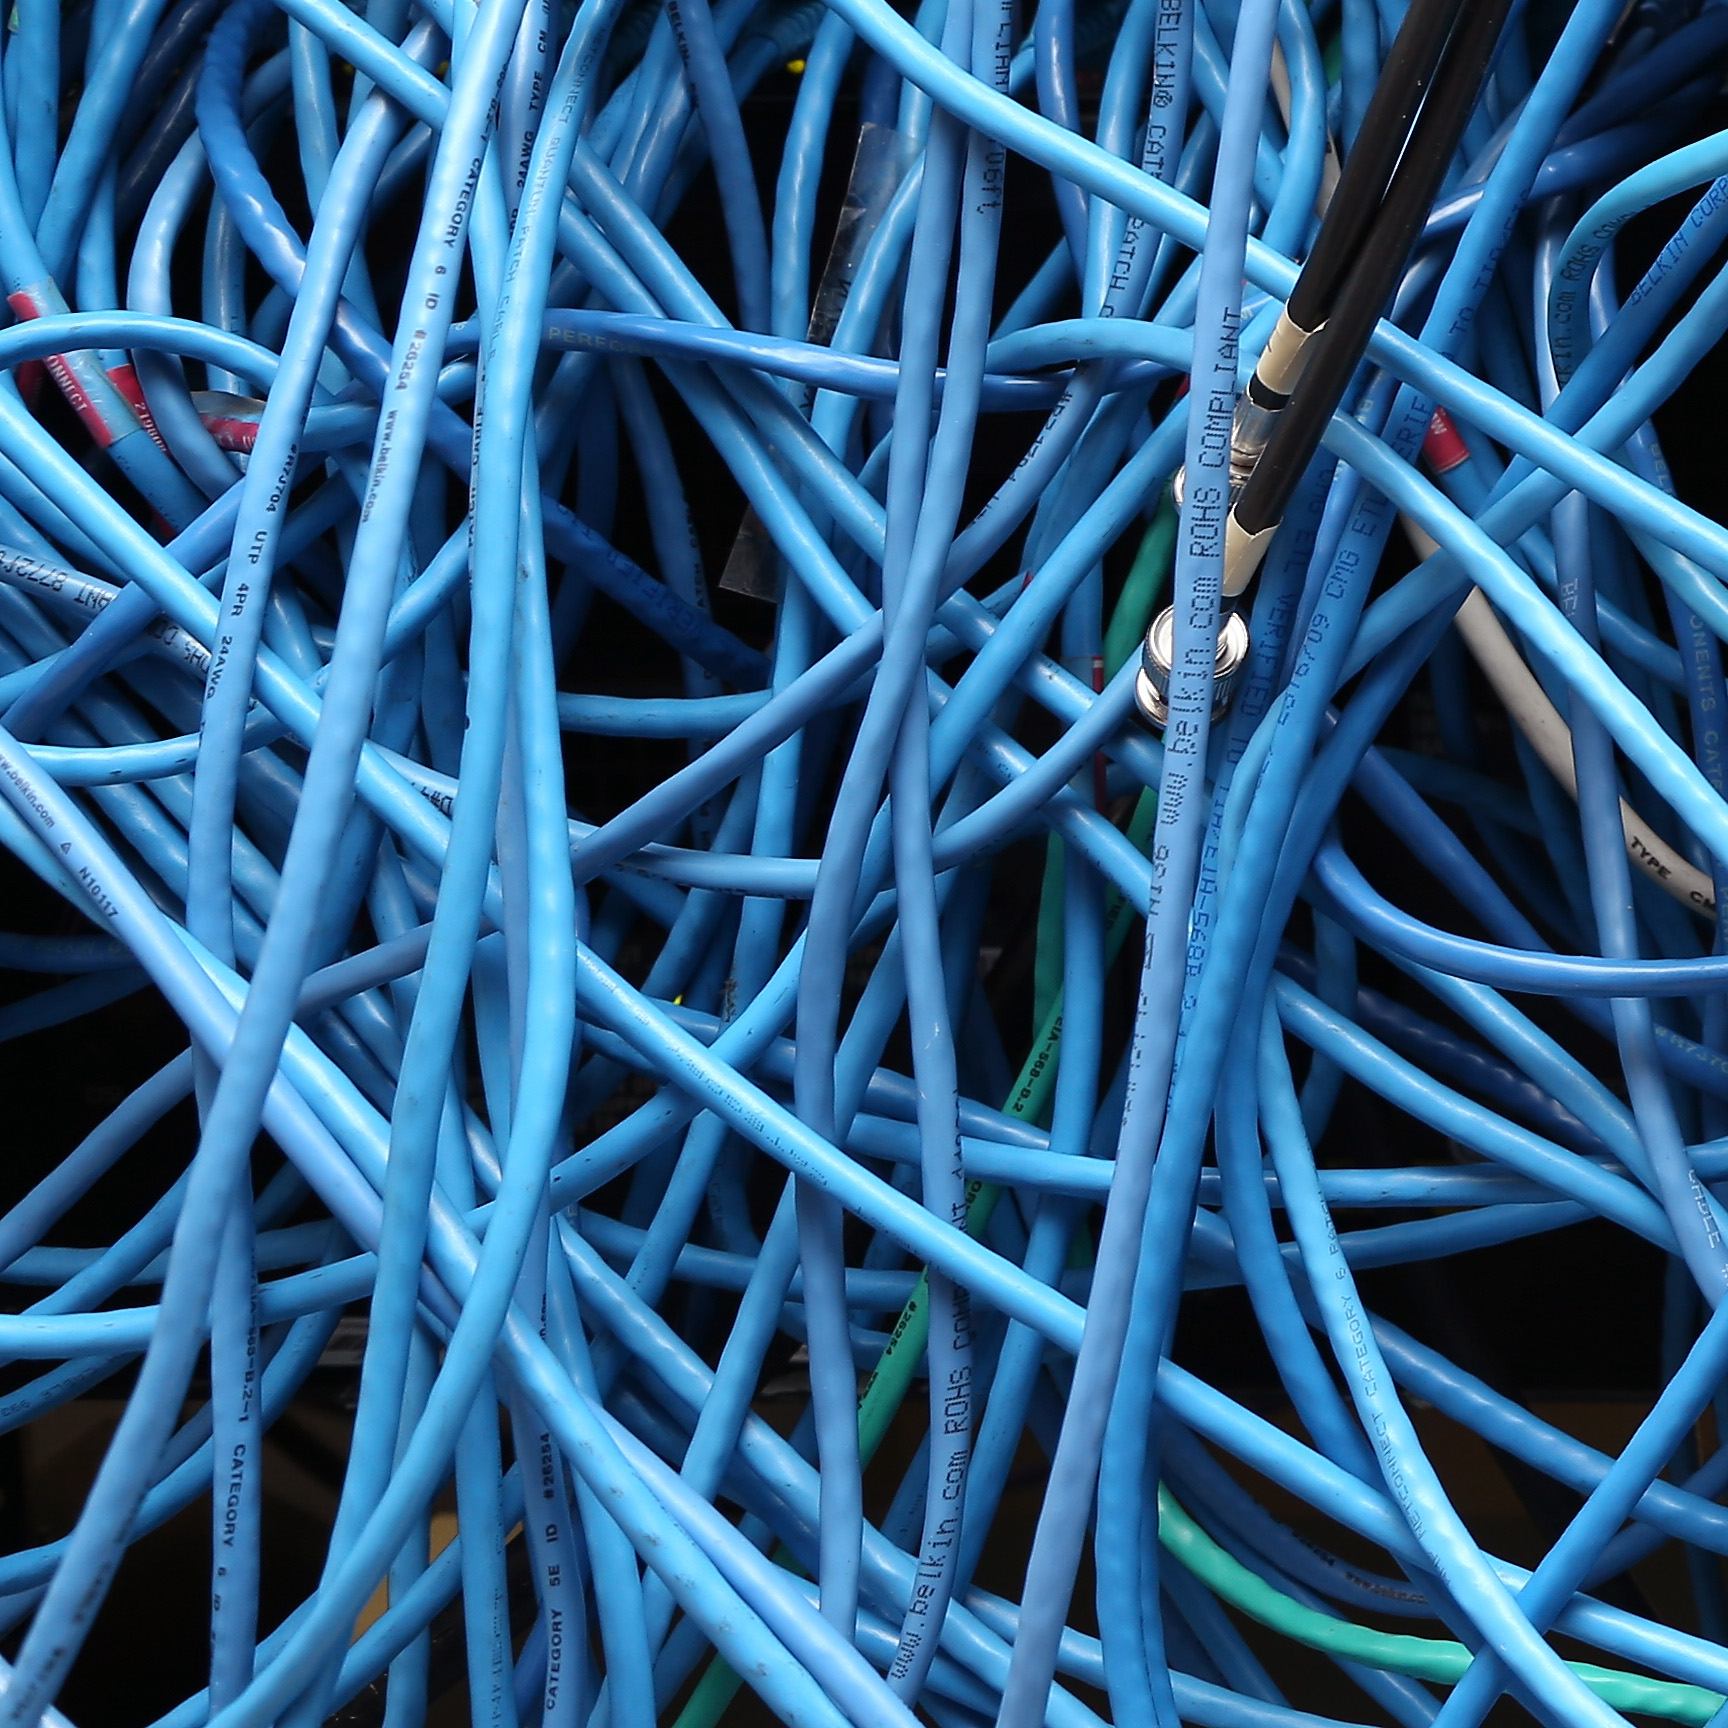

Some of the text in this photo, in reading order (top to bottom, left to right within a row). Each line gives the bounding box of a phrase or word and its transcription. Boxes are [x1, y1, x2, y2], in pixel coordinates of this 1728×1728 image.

[444, 156, 480, 246] CATEGORY
[425, 293, 440, 310] ID
[435, 264, 447, 274] 6
[1628, 229, 1687, 306] BELKIN
[361, 408, 399, 523] www.belkin.com
[1190, 306, 1240, 559] ROHS COMPLIANT
[206, 443, 301, 700] #R7J704 UTP 4PR 24AWG
[77, 866, 121, 918] N10117
[1628, 836, 1673, 881] TYPE
[945, 1369, 971, 1435] ROHS
[222, 1443, 246, 1549] CATEGORY
[547, 1524, 559, 1545] ID
[545, 1608, 563, 1710] CATEGORY
